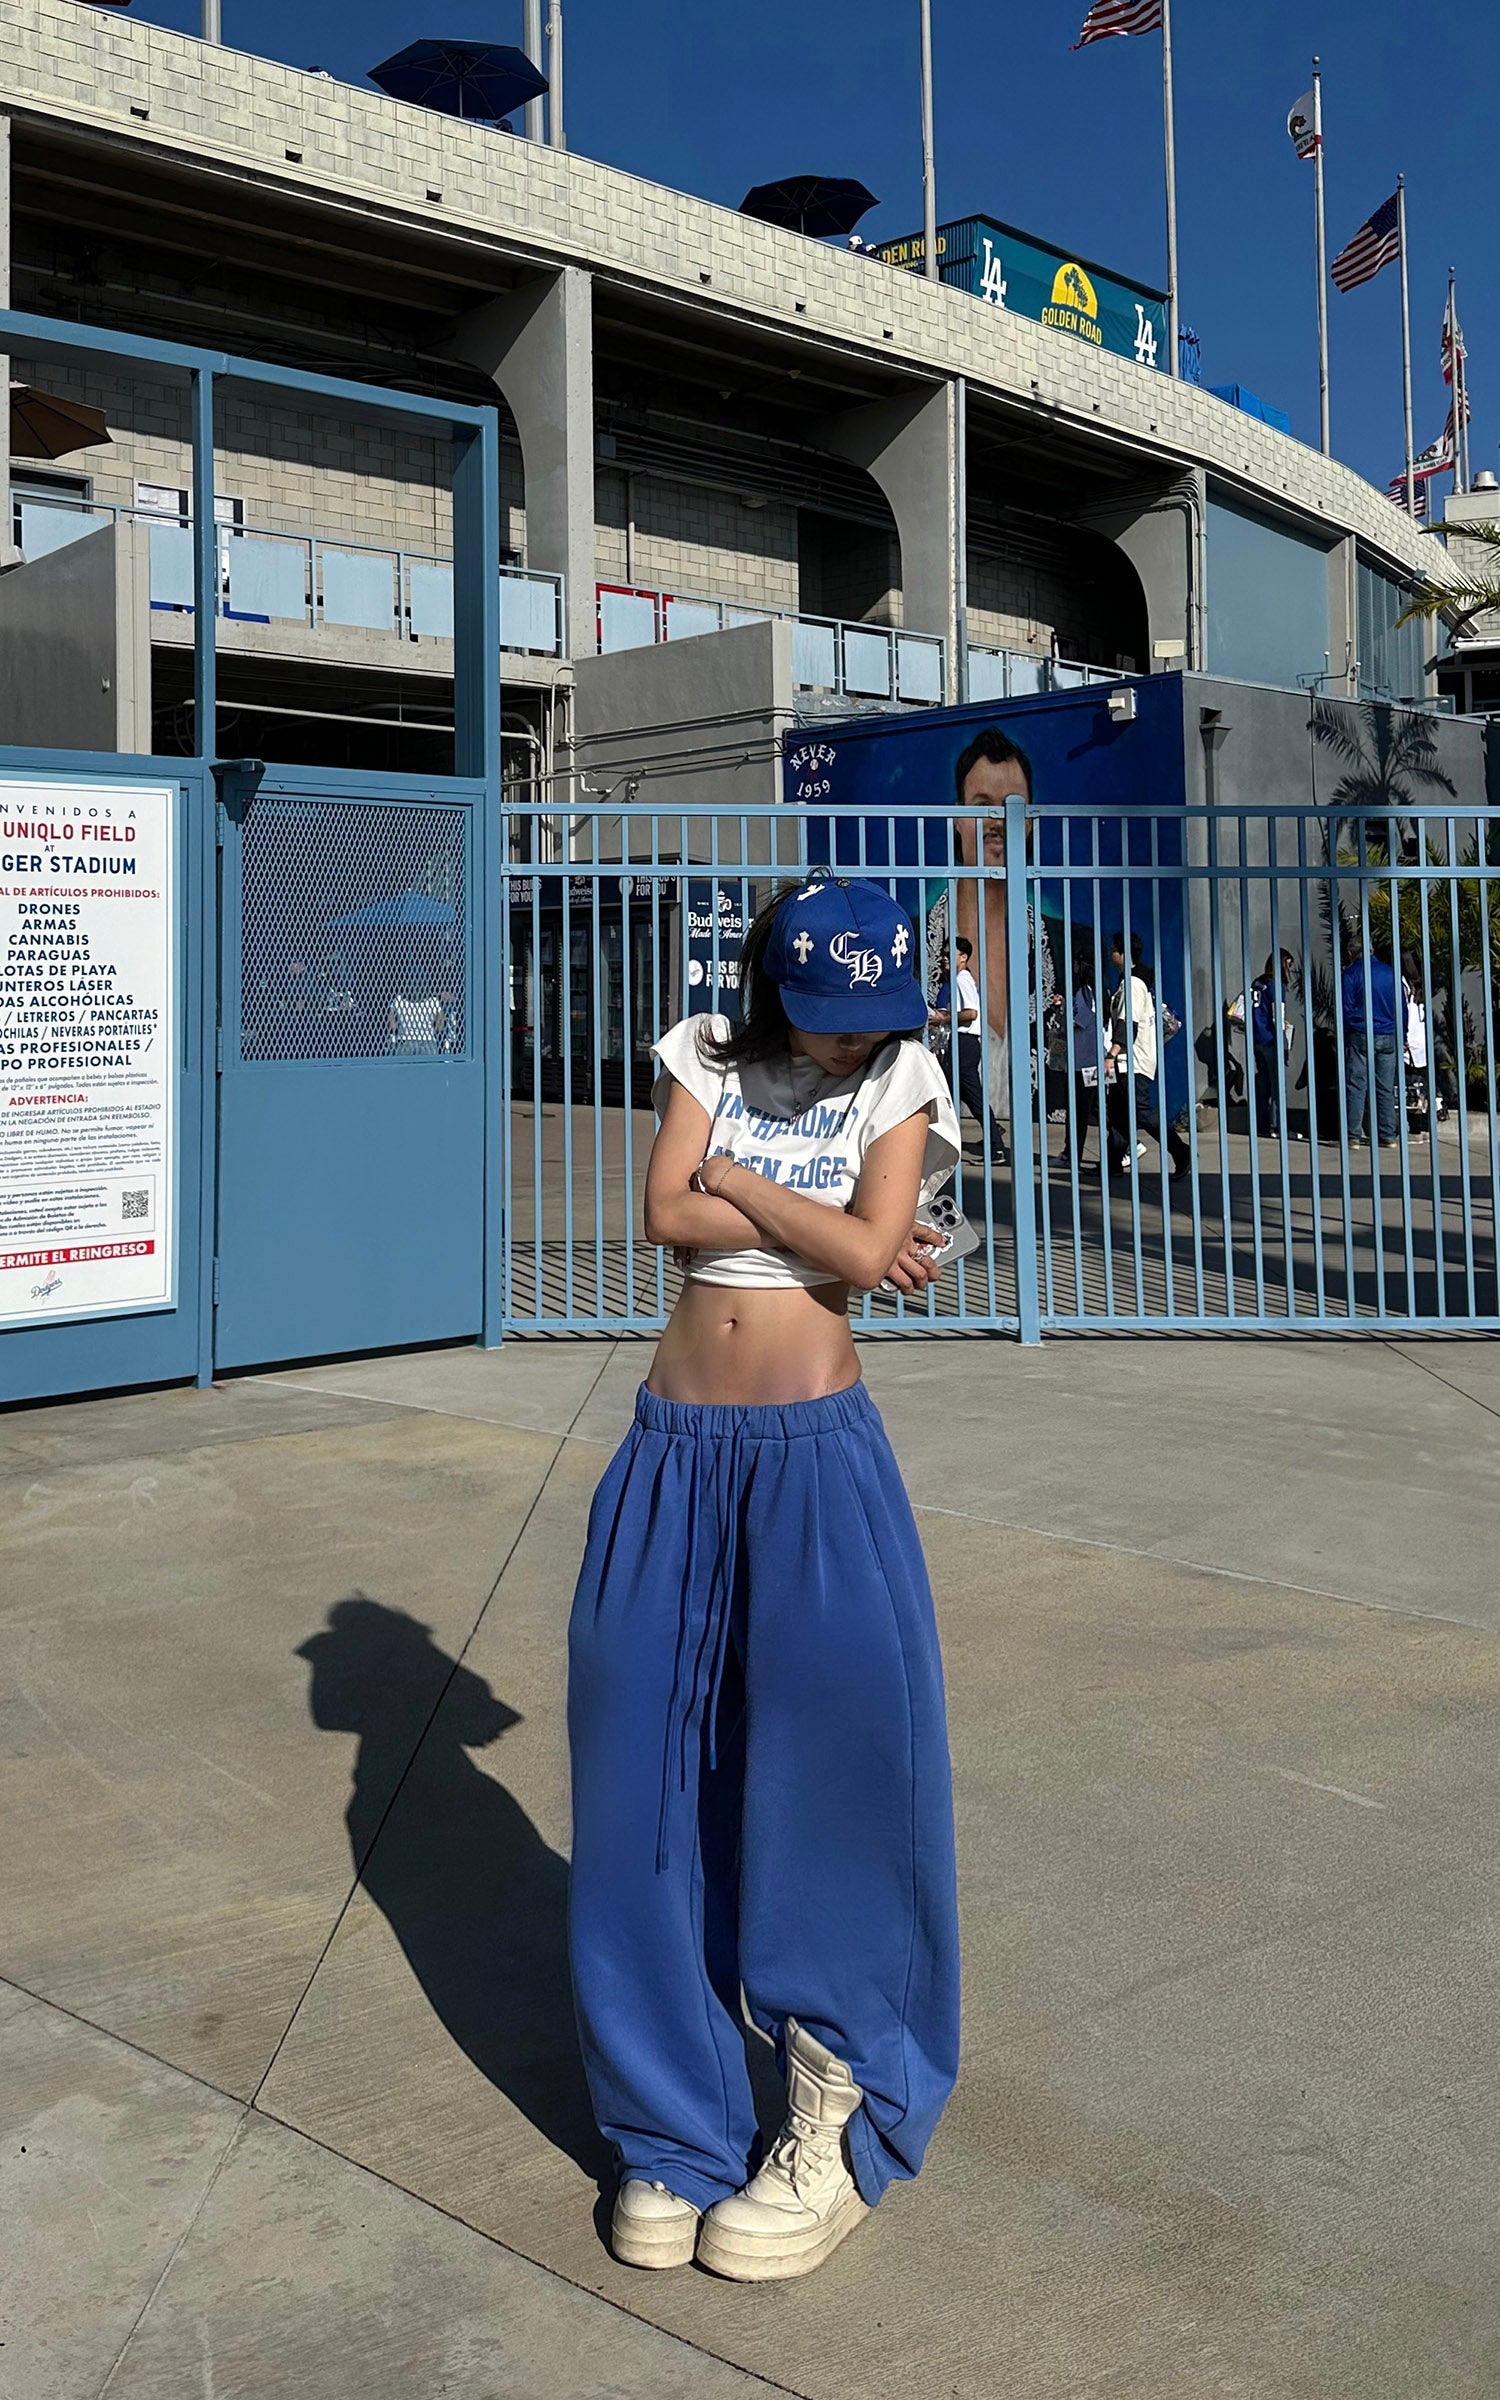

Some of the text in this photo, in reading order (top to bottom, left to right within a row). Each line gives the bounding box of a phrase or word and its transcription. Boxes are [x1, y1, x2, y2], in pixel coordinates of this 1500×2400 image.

[882, 244, 907, 264] DEN
[980, 238, 1007, 308] LA
[1042, 307, 1102, 345] GOLDEN ROAD
[1134, 304, 1157, 367] LA
[790, 744, 836, 771] NEVER
[797, 780, 830, 798] 1959
[0, 804, 112, 818] NVENIDOS
[4, 822, 136, 842] UNIQLO FIELD
[2, 855, 136, 874] GER STADIUM
[13, 888, 26, 896] DE
[30, 886, 88, 896] ARTÍCULOS
[91, 889, 160, 898] PROHIBIDOS:
[18, 904, 80, 914] DRONES
[22, 920, 76, 930] ARMAS
[9, 935, 89, 945] CANNABIS
[8, 950, 90, 960] PARAGUAS
[829, 931, 883, 990] CH
[49, 966, 66, 975] DE
[72, 965, 117, 975] PLAYA
[70, 977, 112, 990] LÁSER
[30, 992, 133, 1007] ALCOHÓLICAS
[17, 1012, 75, 1022] LETREROS
[91, 1009, 158, 1021] PANCARTAS
[52, 1026, 95, 1037] NEVERAS
[0, 1044, 14, 1054] AS
[21, 1040, 140, 1054] PROFESIONALES
[1, 1055, 132, 1070] PO PROFESIONAL
[9, 1094, 88, 1106] ADVERTENCIA:
[47, 1107, 82, 1115] ARTÍCULOS
[84, 1105, 124, 1113] PROHIBIDOS
[782, 1156, 847, 1189] EDGE
[0, 1243, 147, 1268] ERMITE EL REINGRESO
